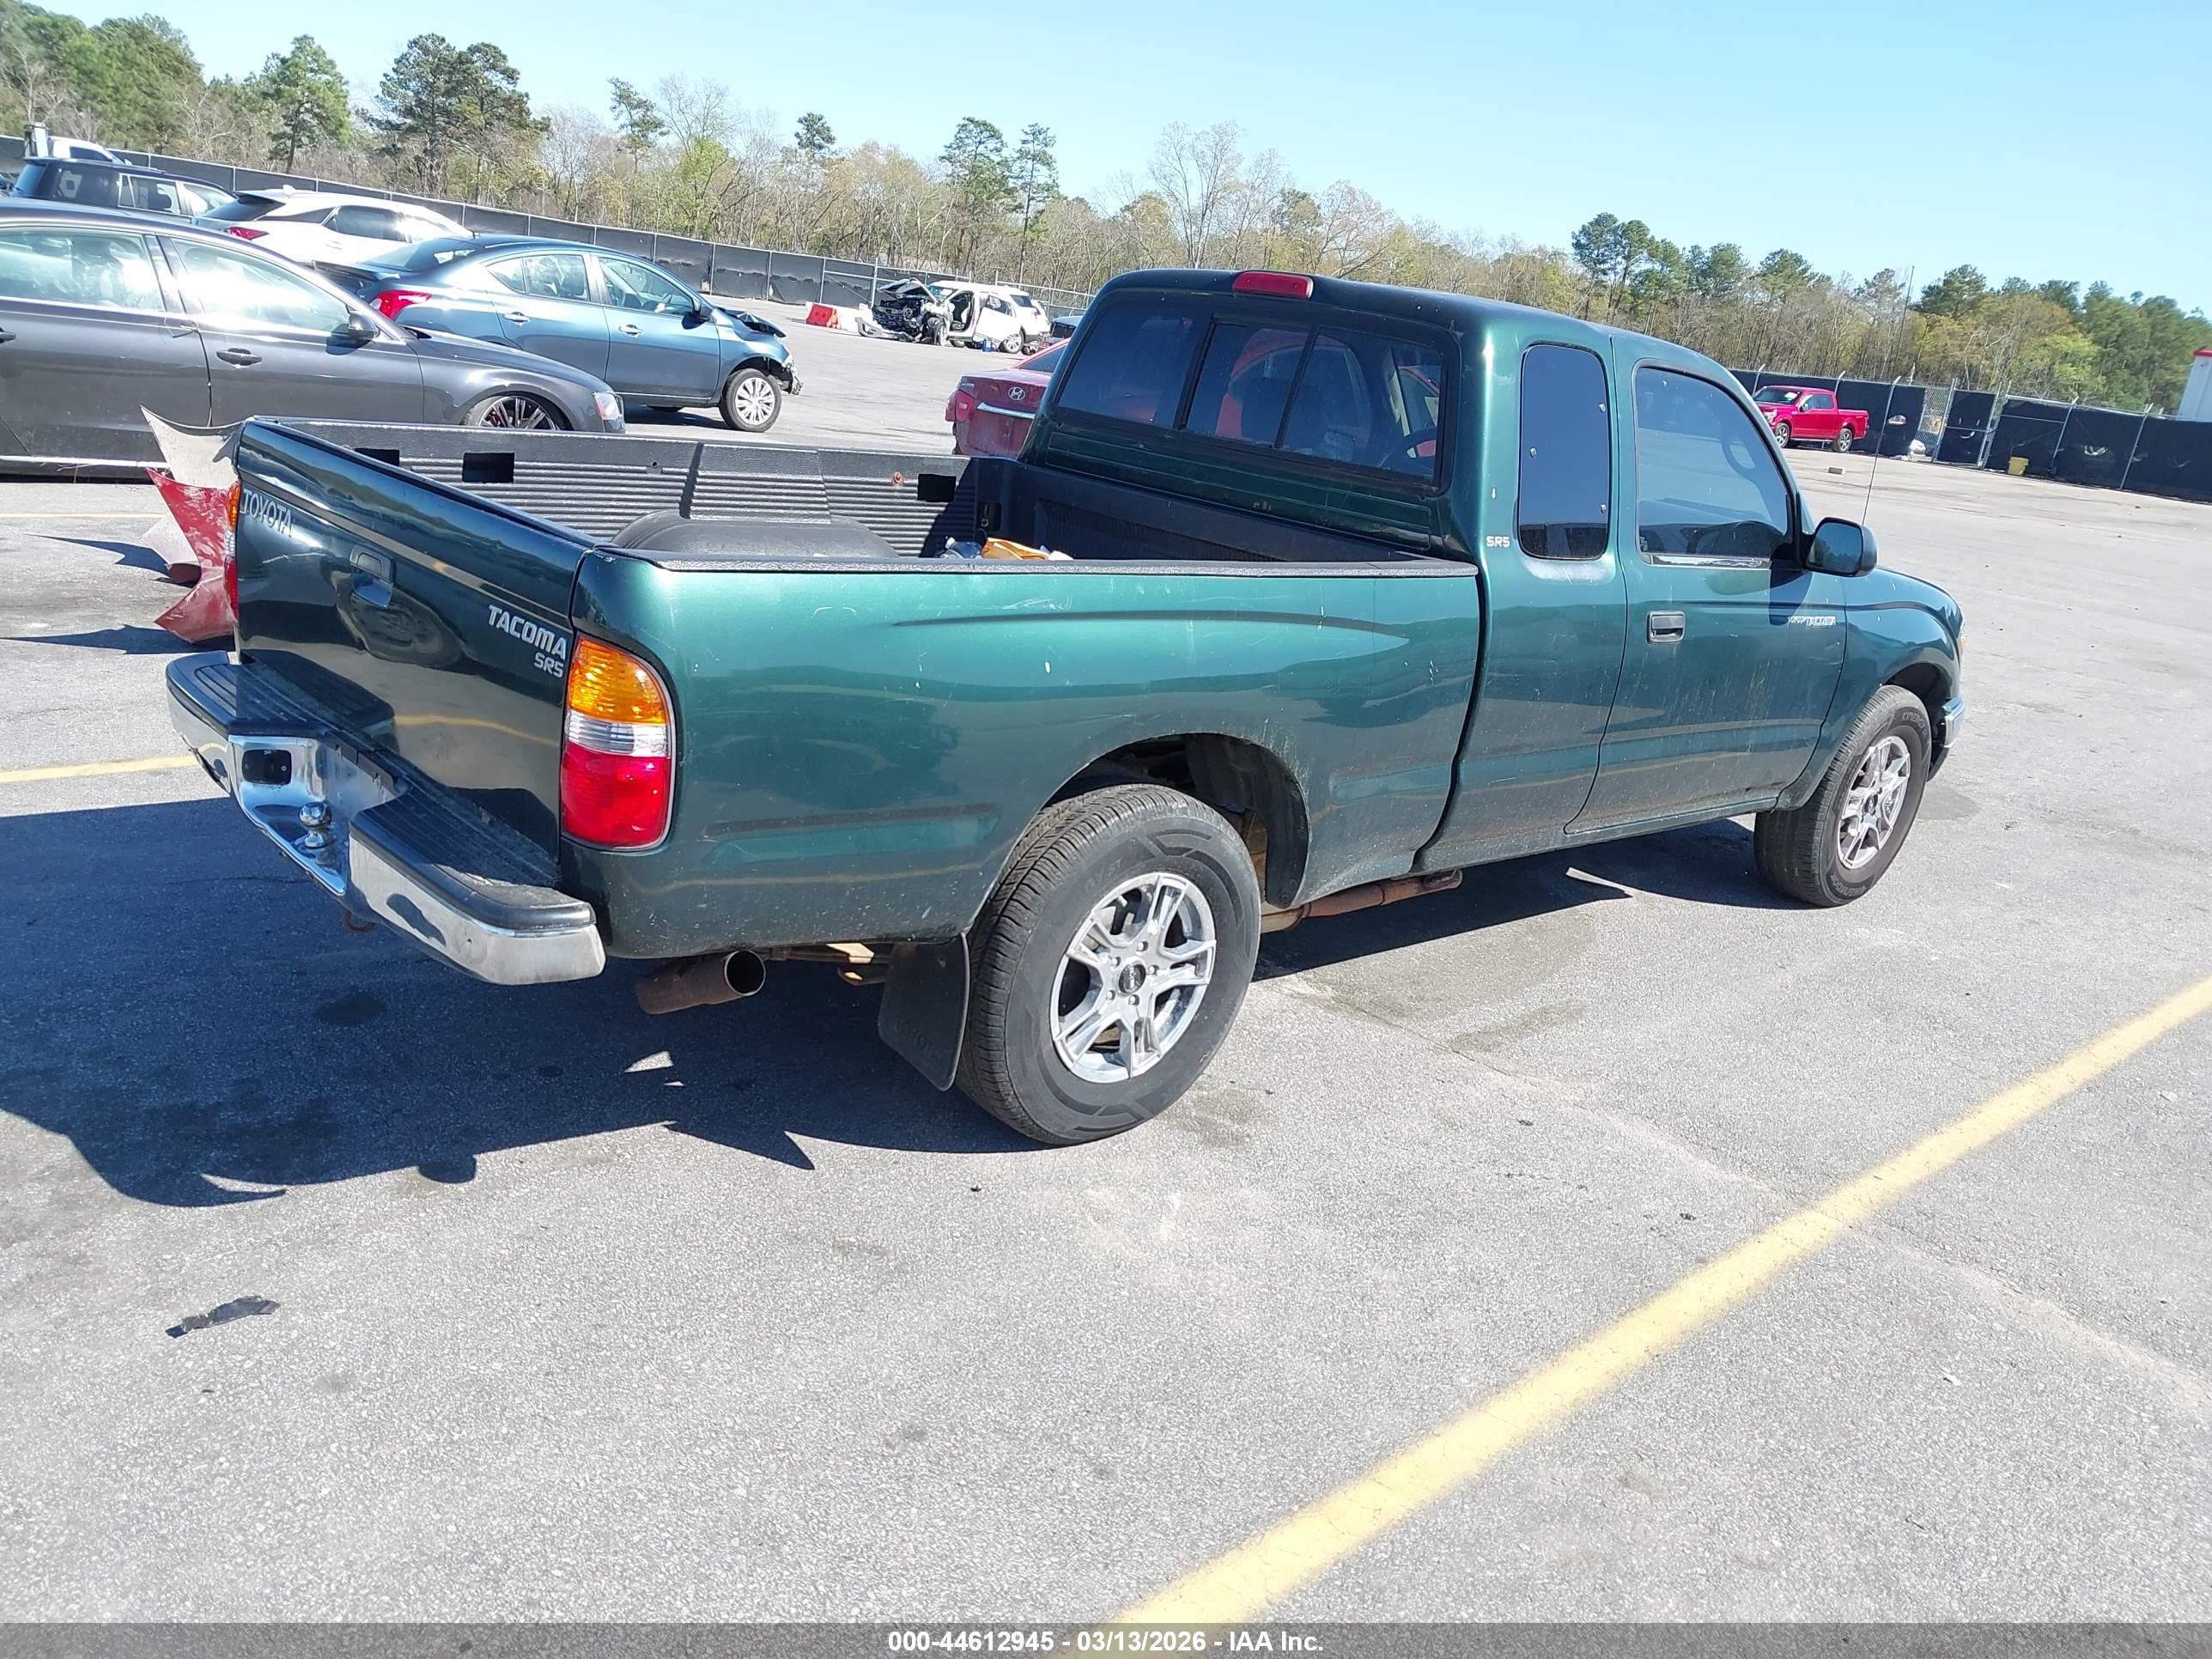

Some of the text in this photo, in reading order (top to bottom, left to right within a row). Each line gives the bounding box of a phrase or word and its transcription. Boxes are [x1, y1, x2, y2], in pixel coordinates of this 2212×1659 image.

[243, 488, 292, 538] TOYOTA
[1486, 535, 1510, 548] SR5
[488, 605, 567, 660] TACOMA
[533, 652, 564, 678] SR5
